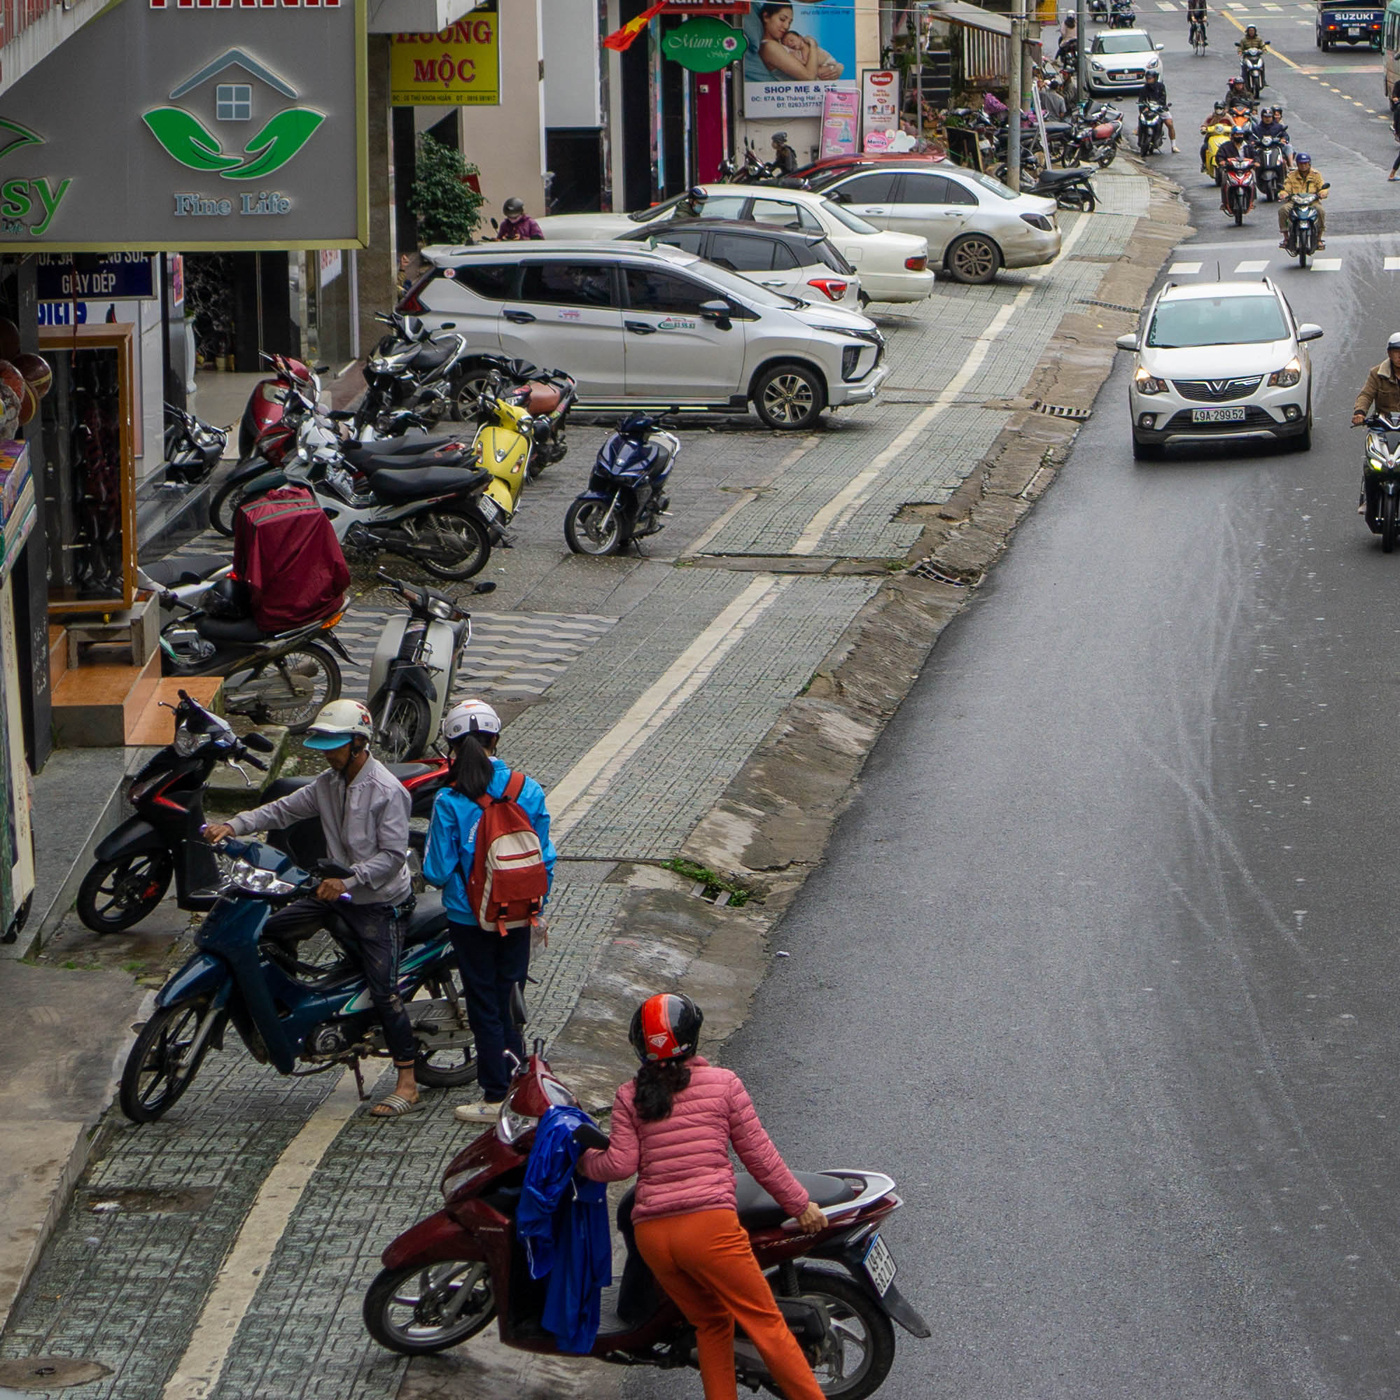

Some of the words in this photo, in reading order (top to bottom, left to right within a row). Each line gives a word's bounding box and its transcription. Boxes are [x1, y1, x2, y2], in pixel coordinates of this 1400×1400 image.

[1335, 13, 1374, 21] SUZUKI
[412, 52, 476, 88] MỘC
[764, 85, 792, 94] SHOP
[799, 84, 816, 97] MẸ
[173, 192, 233, 216] Fine
[239, 191, 292, 216] Life
[93, 267, 116, 293] DÉP
[1193, 407, 1246, 423] 49A-299.52
